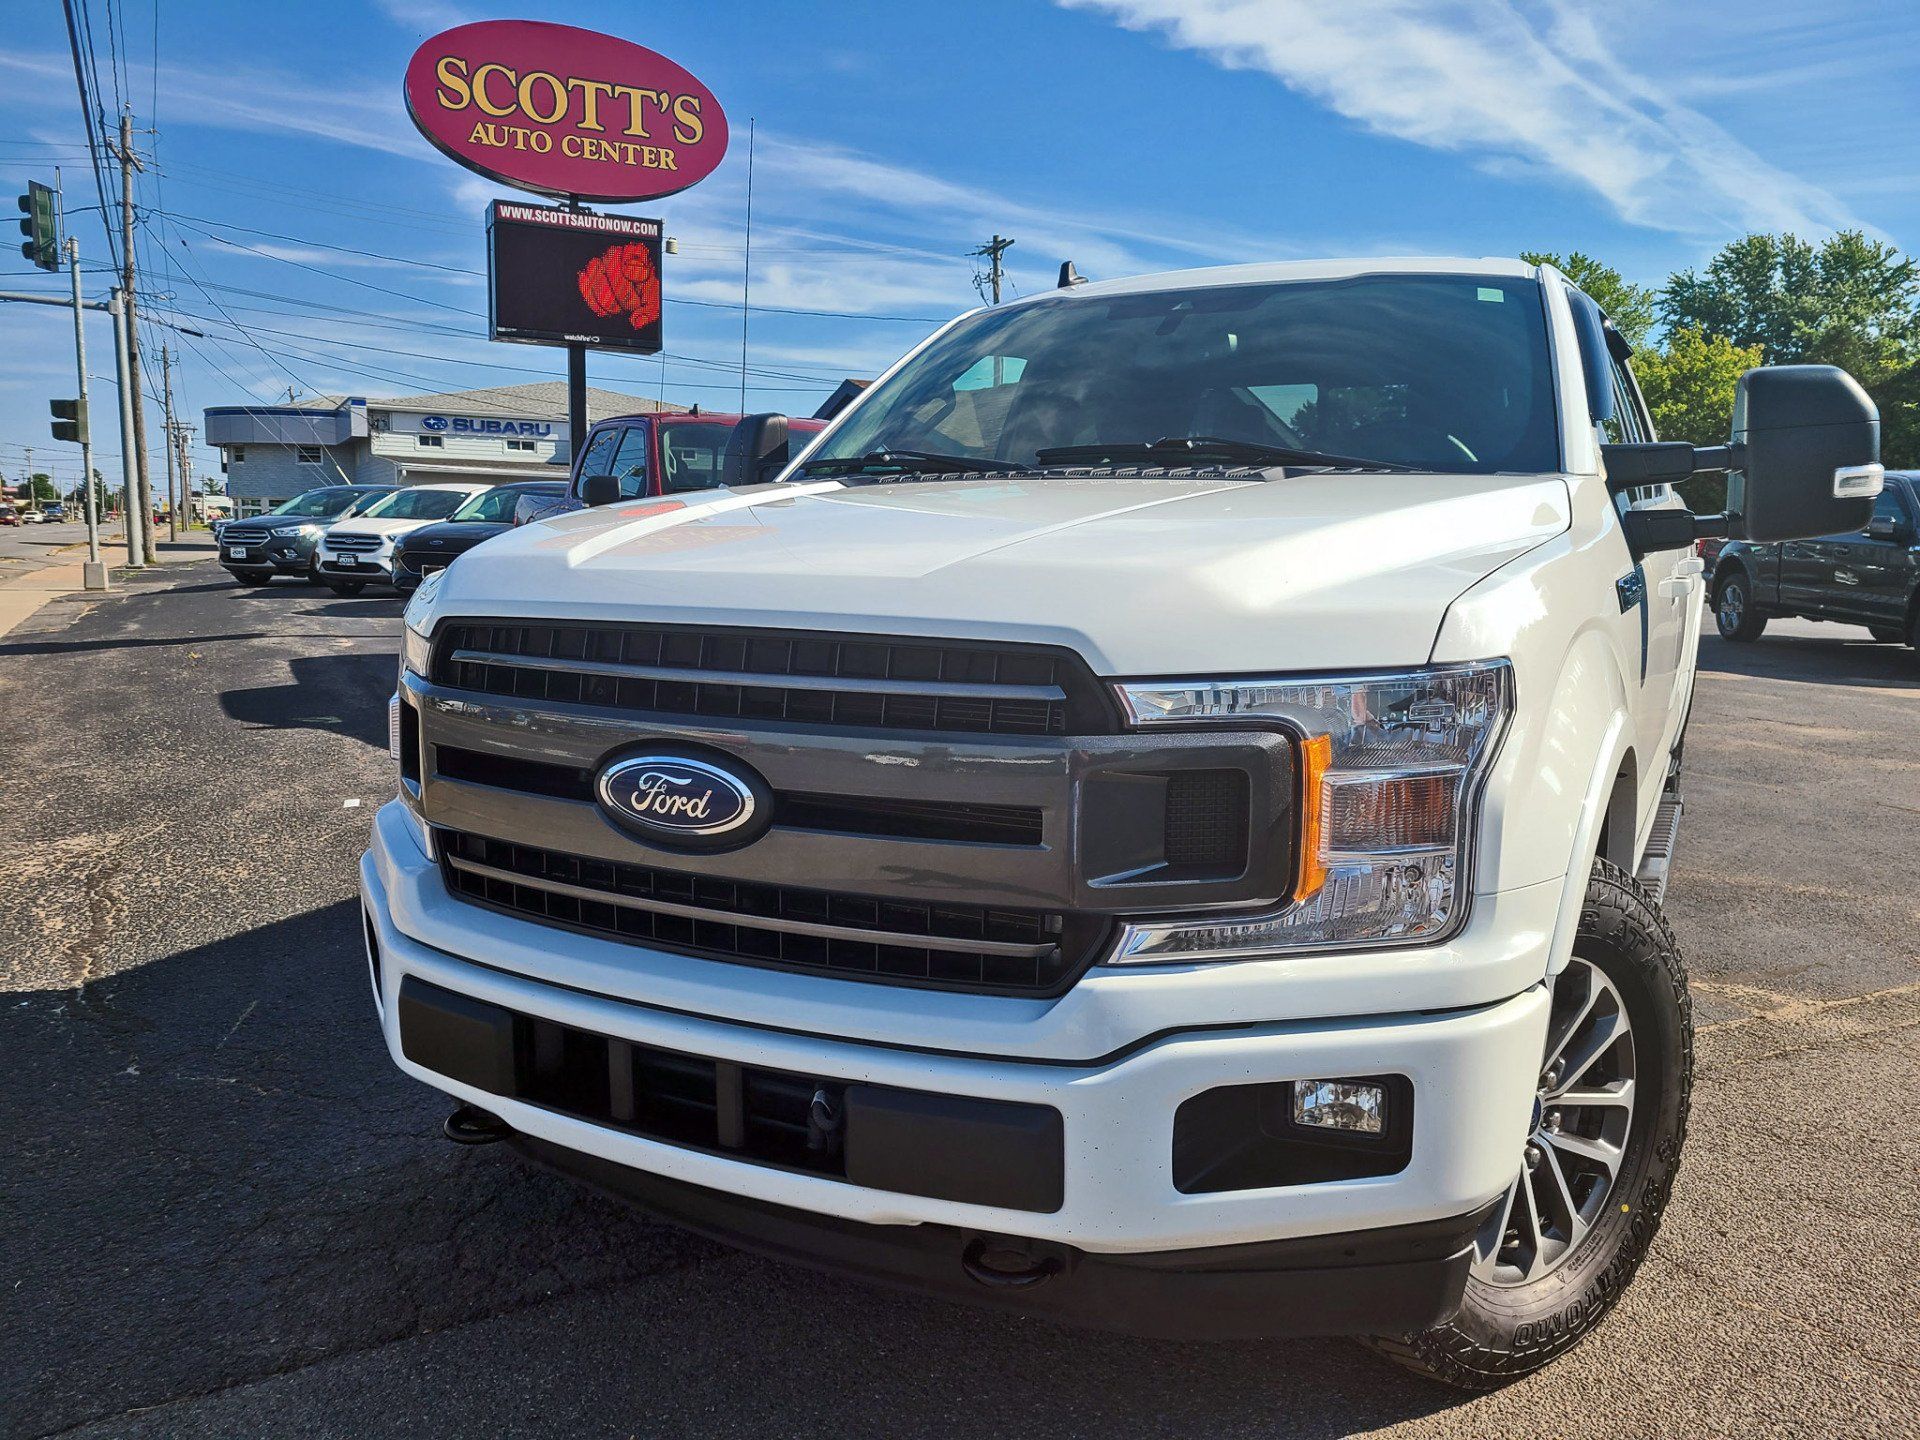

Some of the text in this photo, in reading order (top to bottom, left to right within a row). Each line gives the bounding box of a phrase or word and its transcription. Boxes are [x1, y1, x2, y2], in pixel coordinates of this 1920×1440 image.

[435, 56, 704, 145] SCOTT'S
[468, 121, 679, 171] AUTO CENTER
[500, 205, 658, 236] WWW.SCOTTSAUTONOW.COM
[452, 417, 551, 436] SUBARU
[631, 772, 713, 819] Ford
